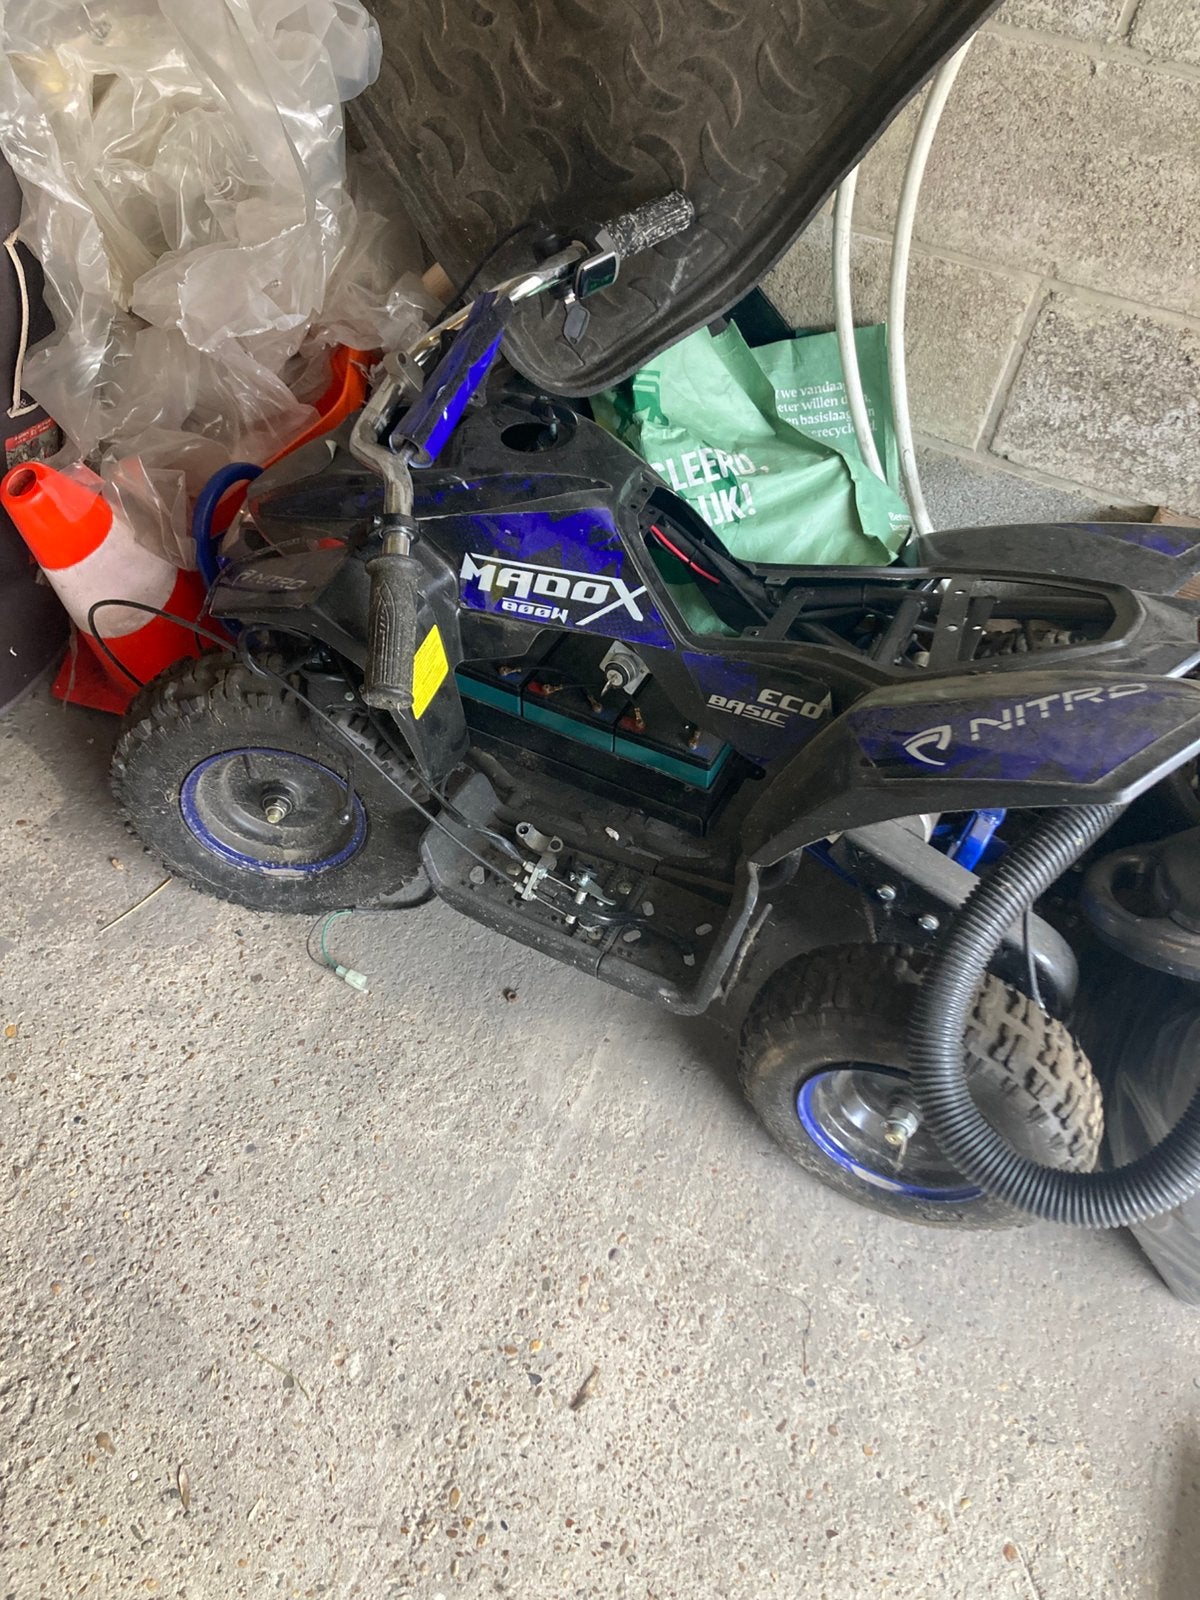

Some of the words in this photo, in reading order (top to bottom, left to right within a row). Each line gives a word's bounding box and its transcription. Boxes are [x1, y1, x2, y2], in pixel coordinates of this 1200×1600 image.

[777, 403, 800, 413] eter
[801, 396, 838, 411] willen
[780, 388, 798, 399] we
[459, 552, 647, 626] MADOX
[501, 597, 569, 625] 800W
[706, 694, 790, 727] BASIC
[757, 688, 826, 720] ECO
[969, 682, 1149, 741] NITRO
